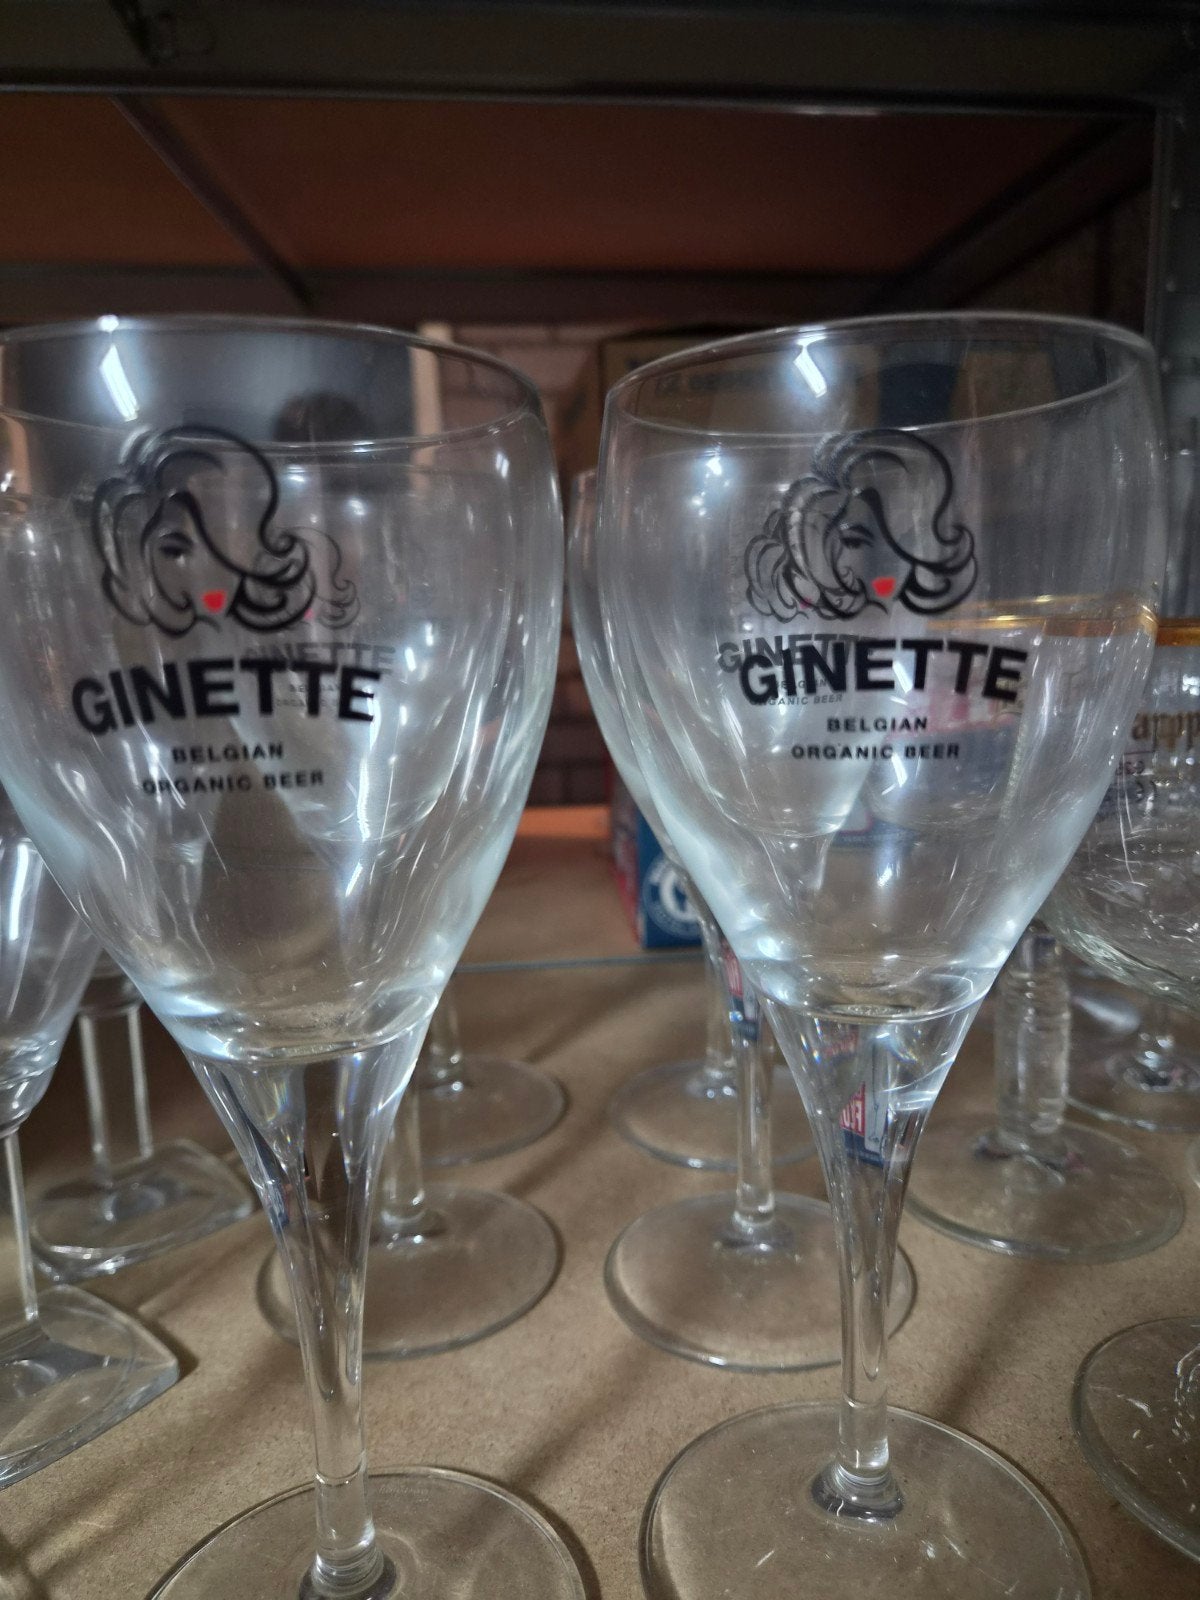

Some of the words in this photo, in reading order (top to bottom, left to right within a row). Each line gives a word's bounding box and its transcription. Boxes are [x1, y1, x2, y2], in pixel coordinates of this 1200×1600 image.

[717, 633, 878, 673] GINETT
[740, 638, 1028, 706] GINETTE
[72, 657, 381, 735] GINETTE
[827, 717, 928, 733] BELGIAN
[172, 743, 284, 763] BELGIAN
[791, 744, 894, 760] ORGANIC
[904, 743, 960, 759] BEER
[142, 775, 251, 795] ORGANIC
[264, 769, 324, 789] BEER
